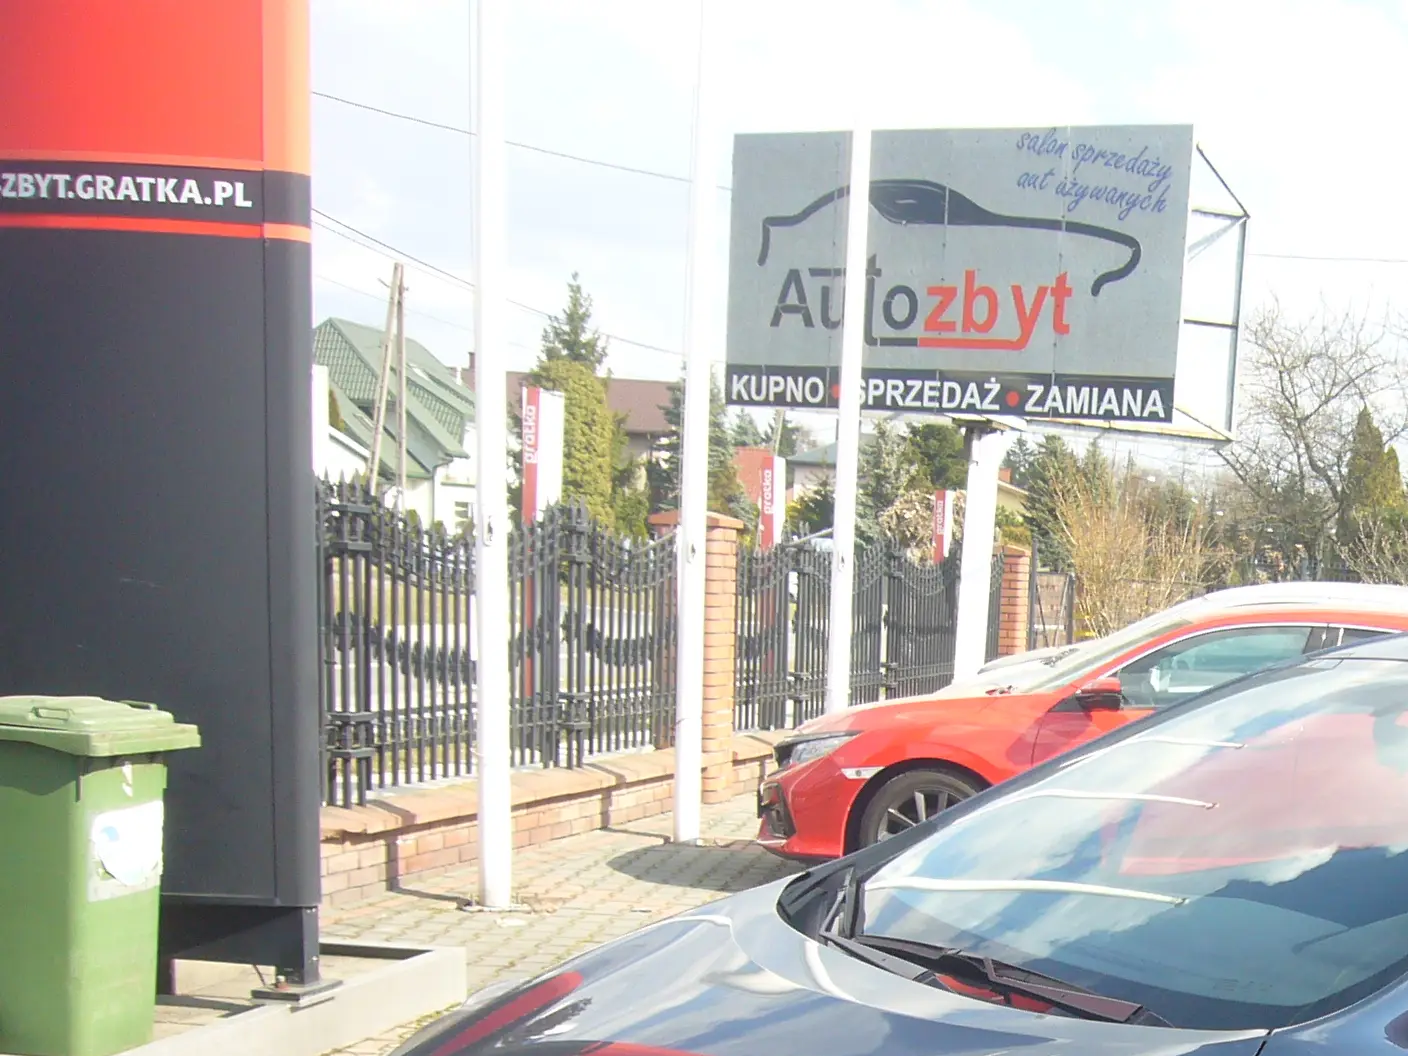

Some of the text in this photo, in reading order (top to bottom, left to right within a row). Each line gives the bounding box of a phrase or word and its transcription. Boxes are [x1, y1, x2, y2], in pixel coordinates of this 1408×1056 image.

[1016, 127, 1173, 193] salon sprzedaży
[0, 172, 252, 208] ZBYT.GRATKA.PL
[1016, 168, 1169, 221] aut używanych
[731, 374, 824, 404] KUPNO
[1024, 384, 1165, 418] ZAMIANA
[523, 405, 538, 464] gratka
